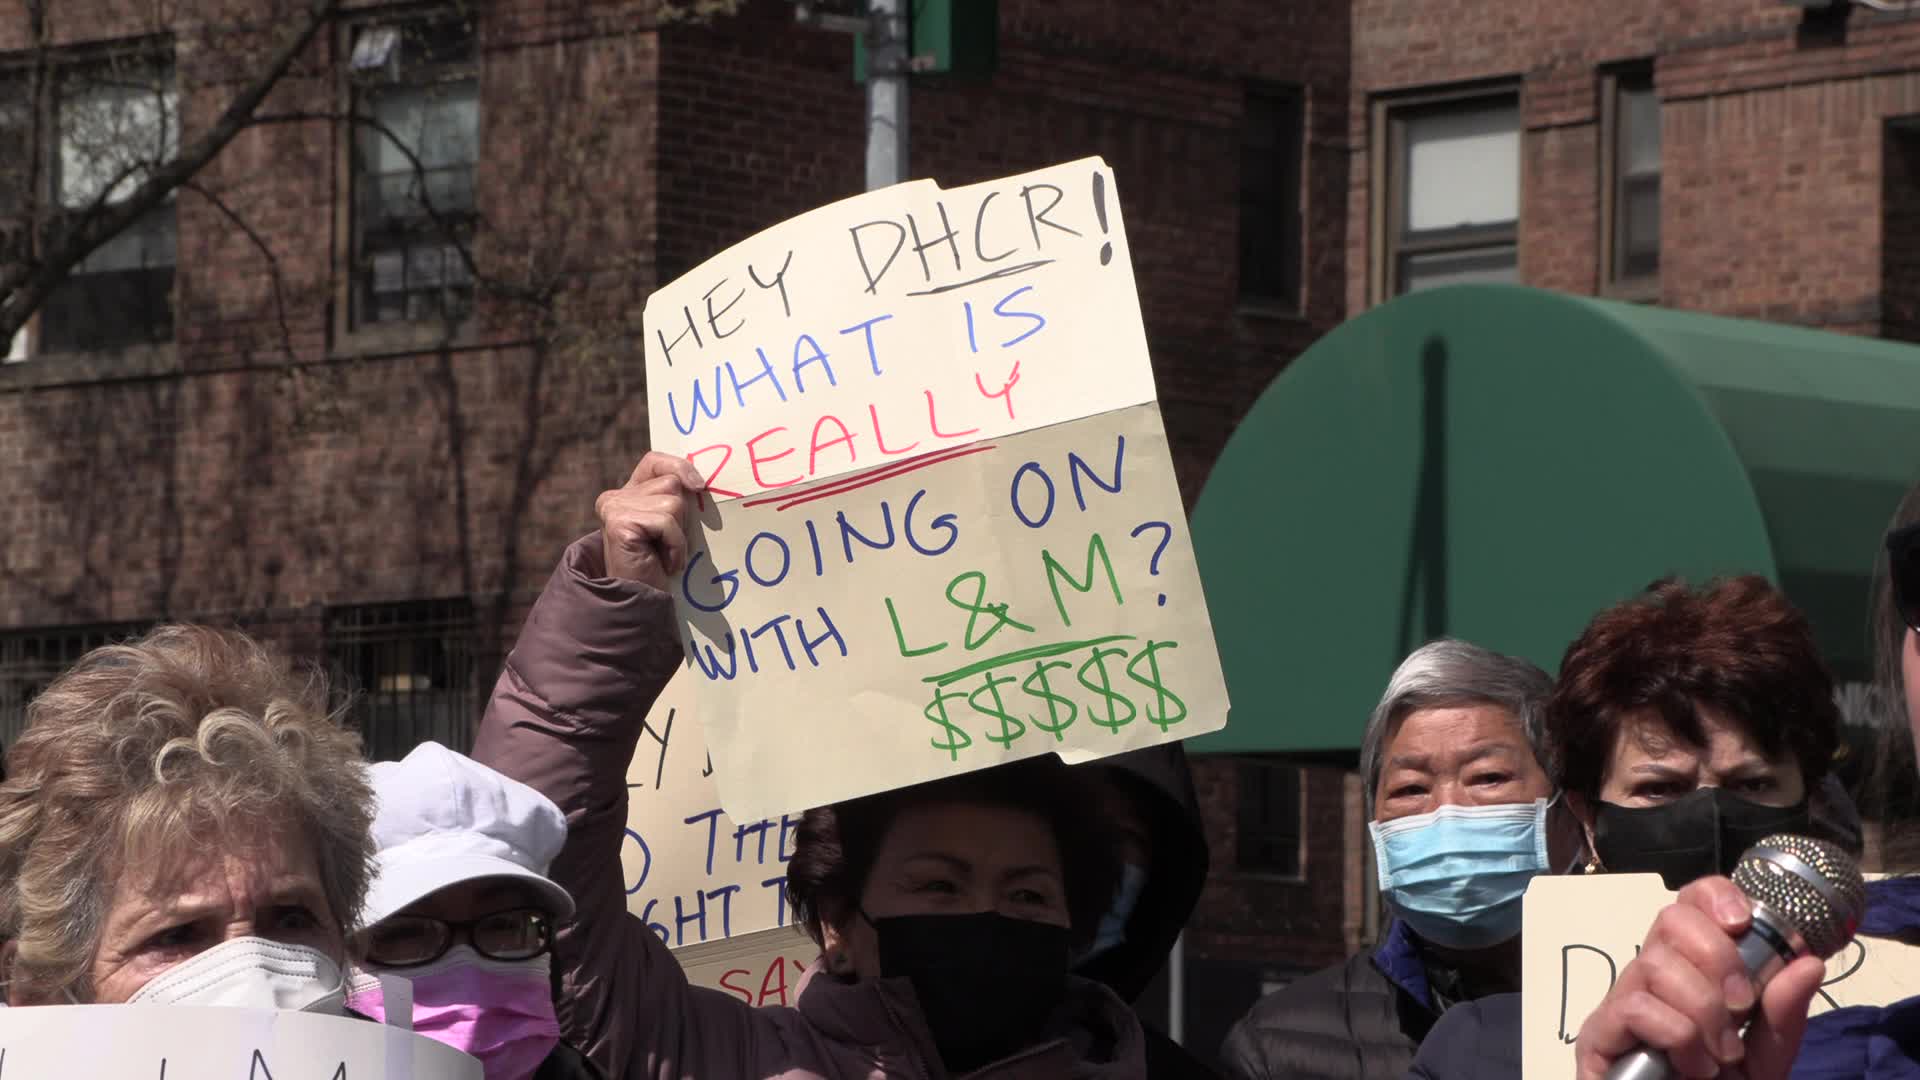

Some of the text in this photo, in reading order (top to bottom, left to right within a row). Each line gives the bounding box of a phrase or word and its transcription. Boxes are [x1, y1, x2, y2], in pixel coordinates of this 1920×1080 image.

[658, 250, 793, 366] HEY
[667, 286, 1046, 435] WHAT IS
[686, 360, 1022, 512] REALLY
[682, 435, 1125, 612] GOING ON
[690, 606, 848, 681] WITH
[923, 640, 1188, 761] $$$$$
[641, 885, 741, 946] GHT
